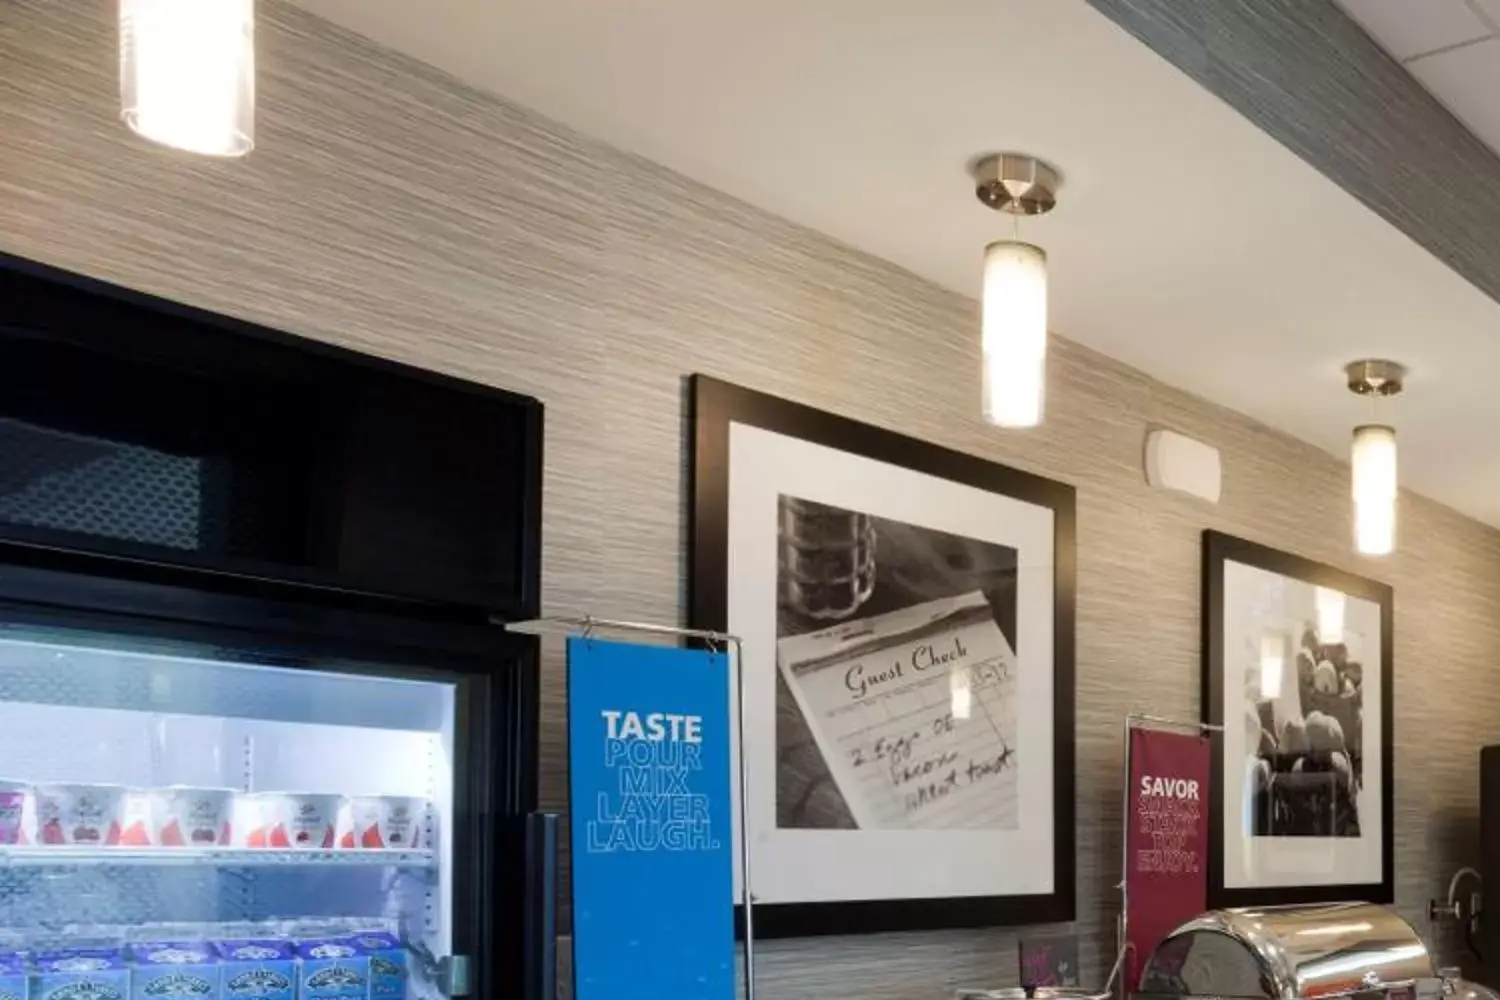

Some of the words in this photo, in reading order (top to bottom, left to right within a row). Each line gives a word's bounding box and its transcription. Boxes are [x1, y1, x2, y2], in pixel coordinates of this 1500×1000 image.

[845, 661, 904, 699] Guest
[911, 637, 967, 671] Check
[601, 710, 703, 742] TASTE
[605, 738, 703, 770] POUR
[619, 766, 691, 797] MIX
[1140, 775, 1200, 800] SAVOR
[597, 791, 711, 824] LAYER
[586, 820, 722, 853] LAUGH.
